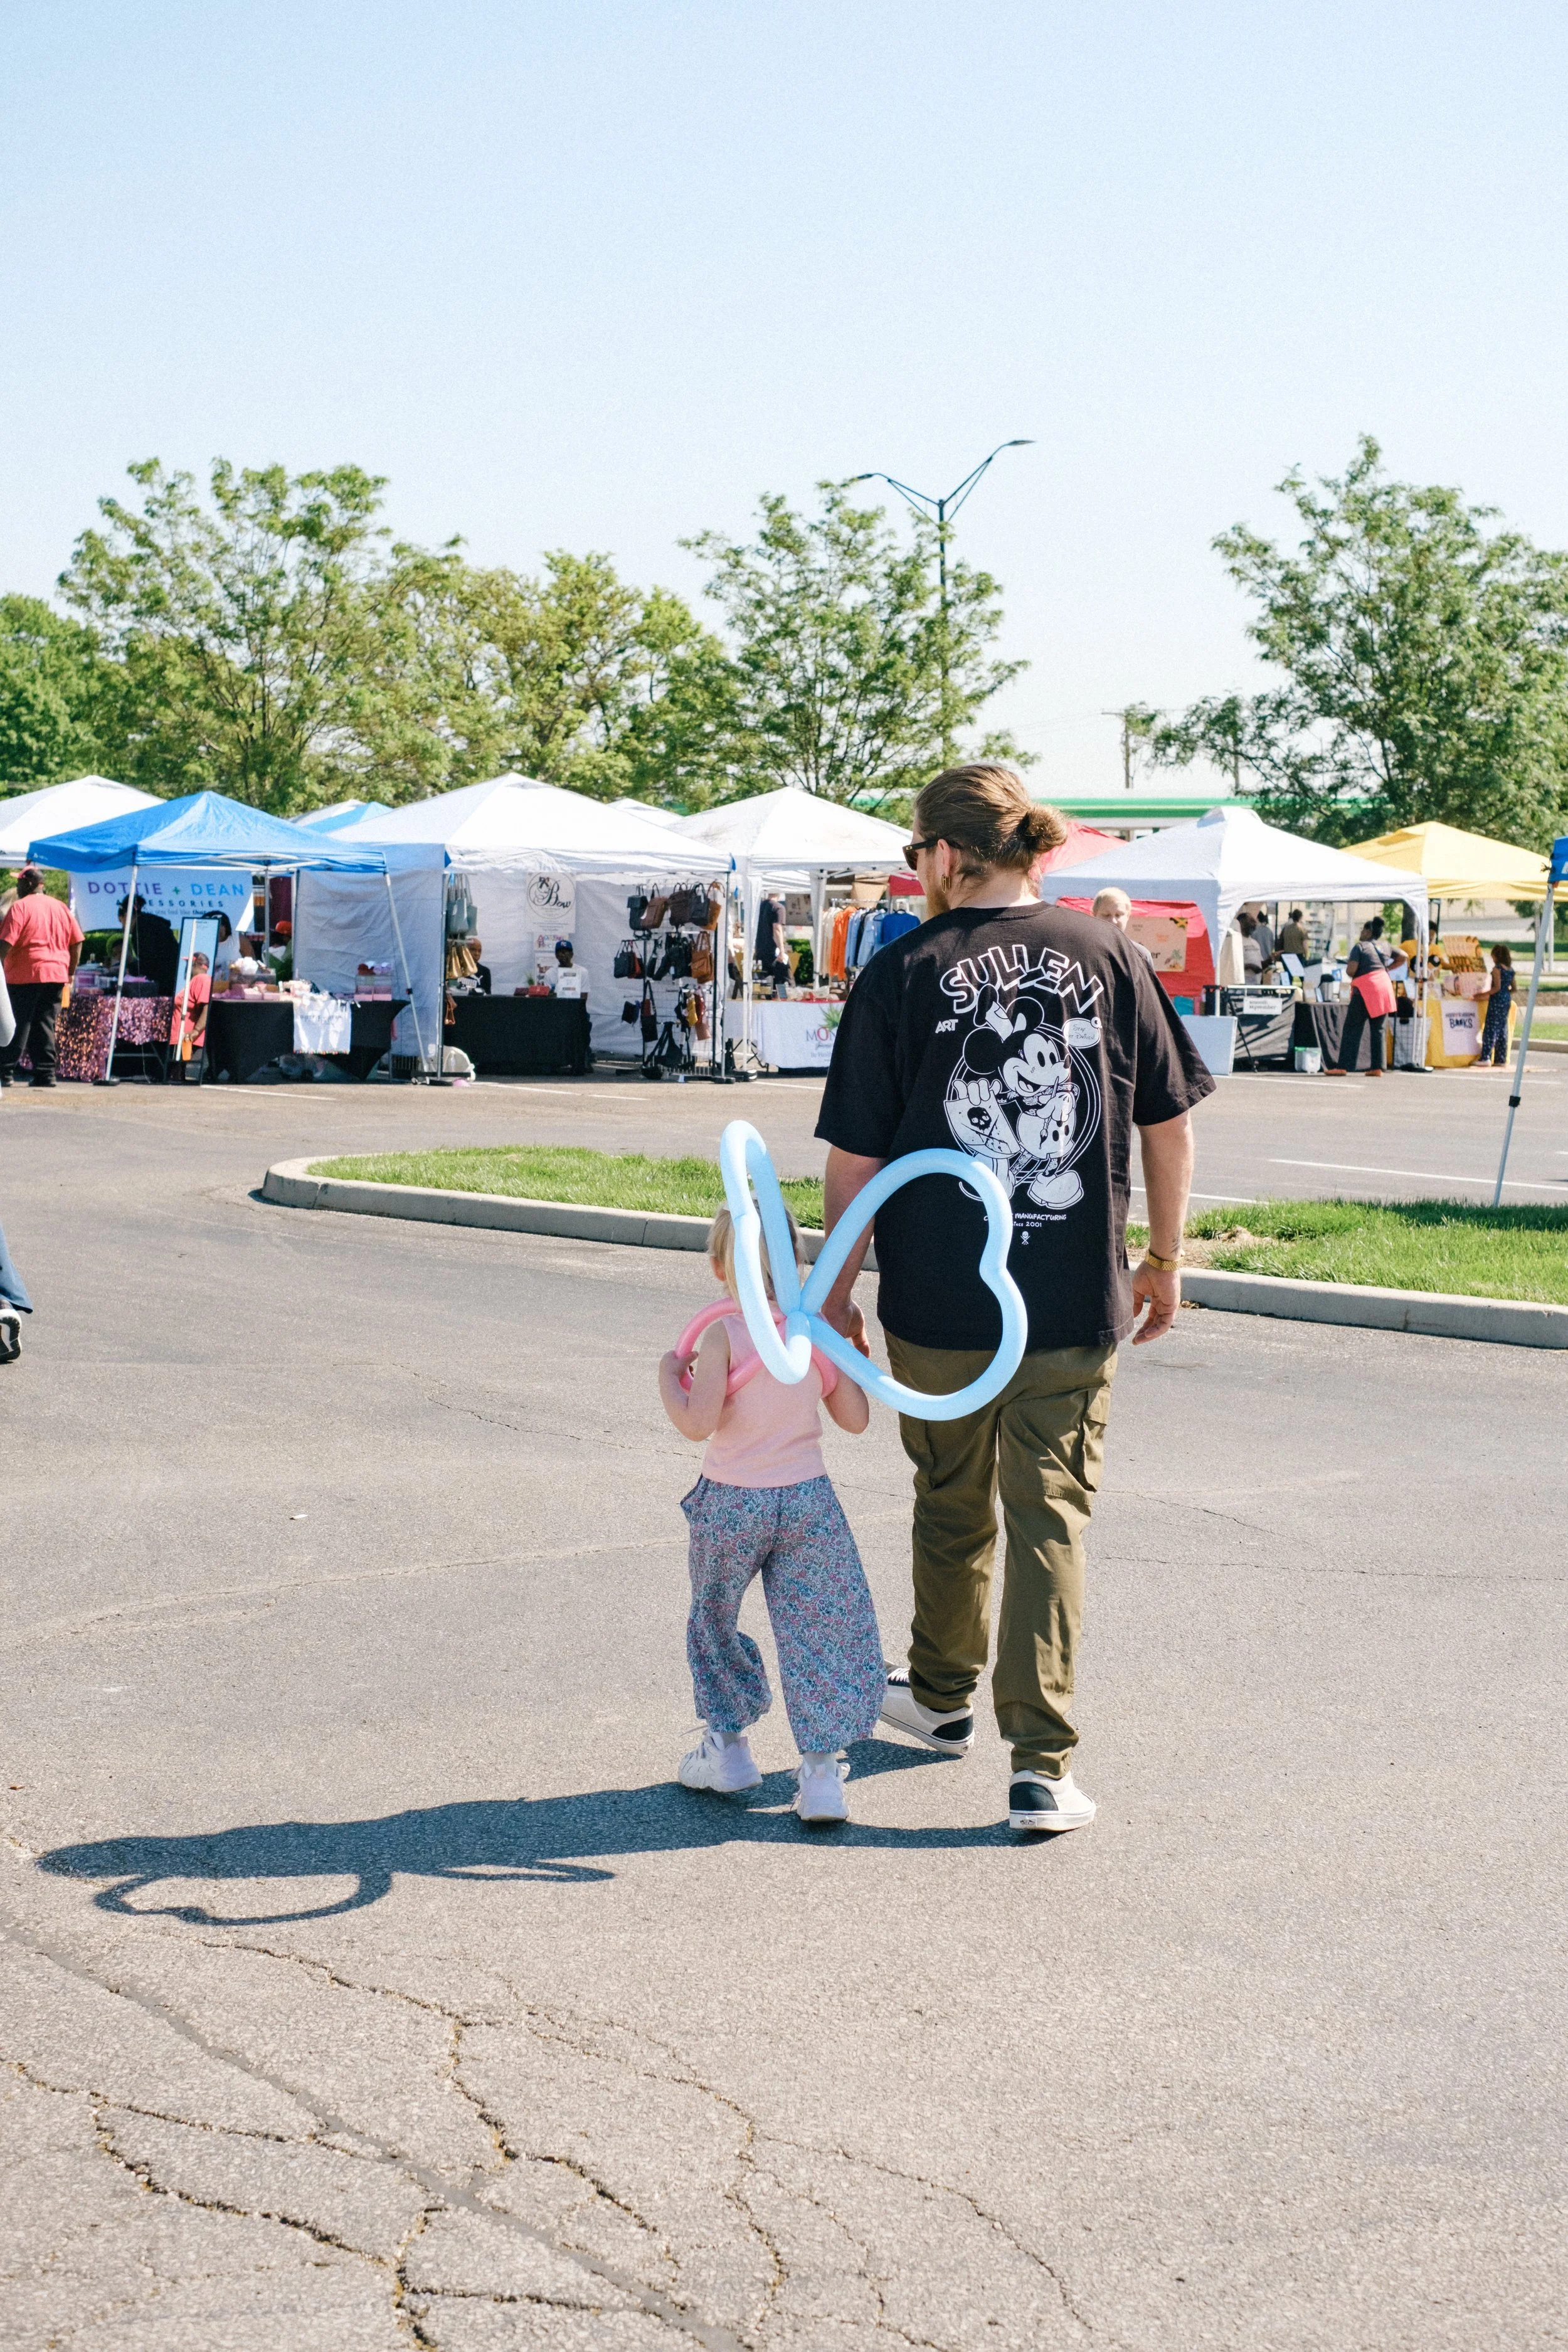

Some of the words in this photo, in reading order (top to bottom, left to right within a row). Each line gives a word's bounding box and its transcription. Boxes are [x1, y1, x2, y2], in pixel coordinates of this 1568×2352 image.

[87, 881, 162, 894] DOTTIE
[191, 883, 245, 896] DEAN
[116, 899, 223, 907] AESSORIES
[940, 945, 1104, 1014] SULLEN
[935, 1019, 958, 1034] ART
